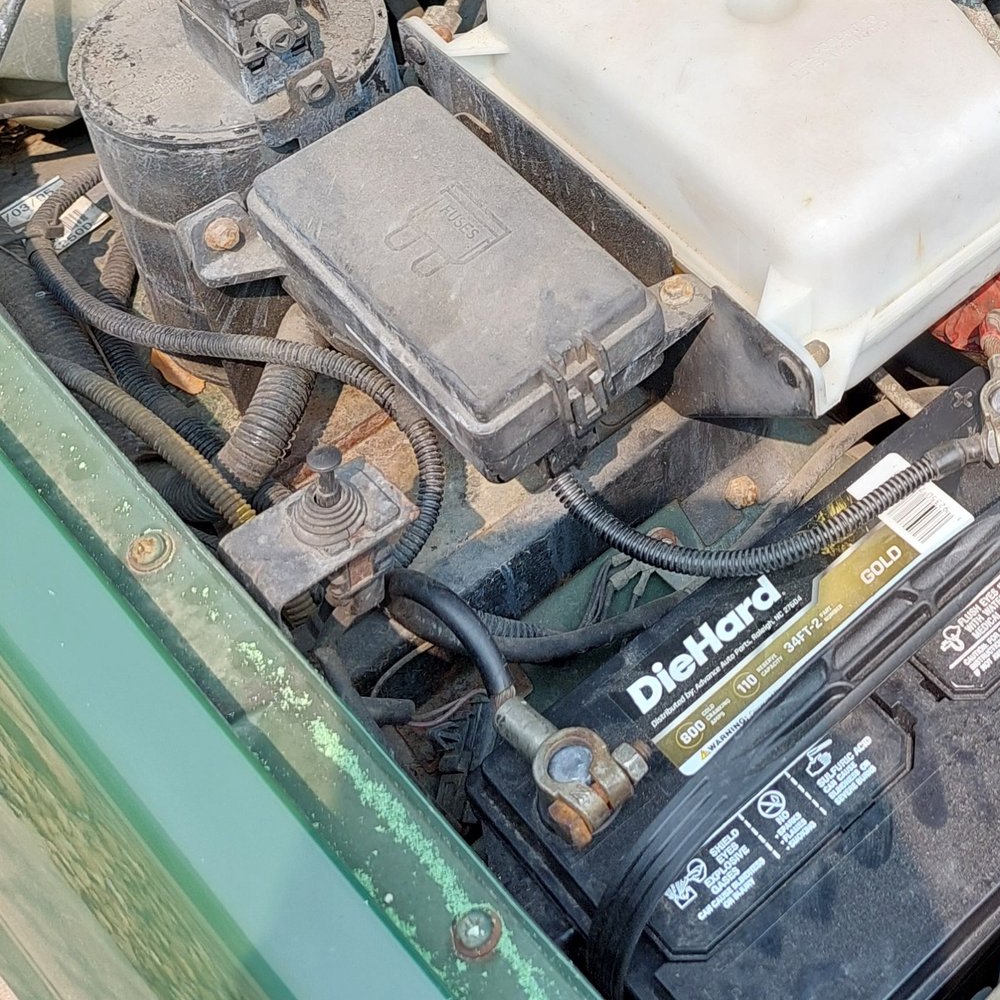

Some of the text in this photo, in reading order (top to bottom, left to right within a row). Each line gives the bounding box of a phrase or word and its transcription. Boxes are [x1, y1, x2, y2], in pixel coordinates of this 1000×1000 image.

[439, 203, 480, 240] FUSES
[859, 544, 902, 585] GOLD
[956, 604, 981, 627] FLUSH
[978, 587, 999, 606] EYES
[783, 617, 822, 653] 34FT-2
[964, 614, 984, 632] WITH
[629, 575, 776, 710] DieHard
[985, 631, 1000, 645] FOR
[651, 695, 685, 726] Distributed
[695, 665, 720, 689] Advance
[719, 653, 735, 667] Auto
[734, 638, 751, 655] Parts,
[751, 617, 775, 641] Raleigh,
[773, 610, 783, 621] NC
[782, 594, 802, 613] 27604
[756, 652, 776, 672] RESERVE
[760, 656, 783, 676] CAPACITY
[979, 657, 994, 671] NOT
[736, 673, 758, 694] 110
[701, 703, 714, 716] COLD
[706, 698, 730, 720] CRANKING
[710, 710, 725, 725] AMPS
[679, 719, 705, 745] 800
[816, 734, 873, 787] SULFURIC ACID
[822, 761, 857, 793] CAN CAUSE
[828, 758, 871, 798] BLINDNESS OR
[833, 764, 877, 805] SEVERE BURNS
[774, 809, 790, 825] NO
[776, 811, 802, 835] SPARKS
[782, 817, 807, 841] FLAMES
[708, 827, 740, 857] SHIELD
[788, 820, 817, 847] SMOKING
[704, 845, 749, 888] EXPLOSIVE
[715, 841, 739, 864] EYES
[696, 857, 766, 920] CAN CAUSE BLINDNESS
[710, 866, 740, 895] GASES
[721, 877, 756, 909] OR INJURY
